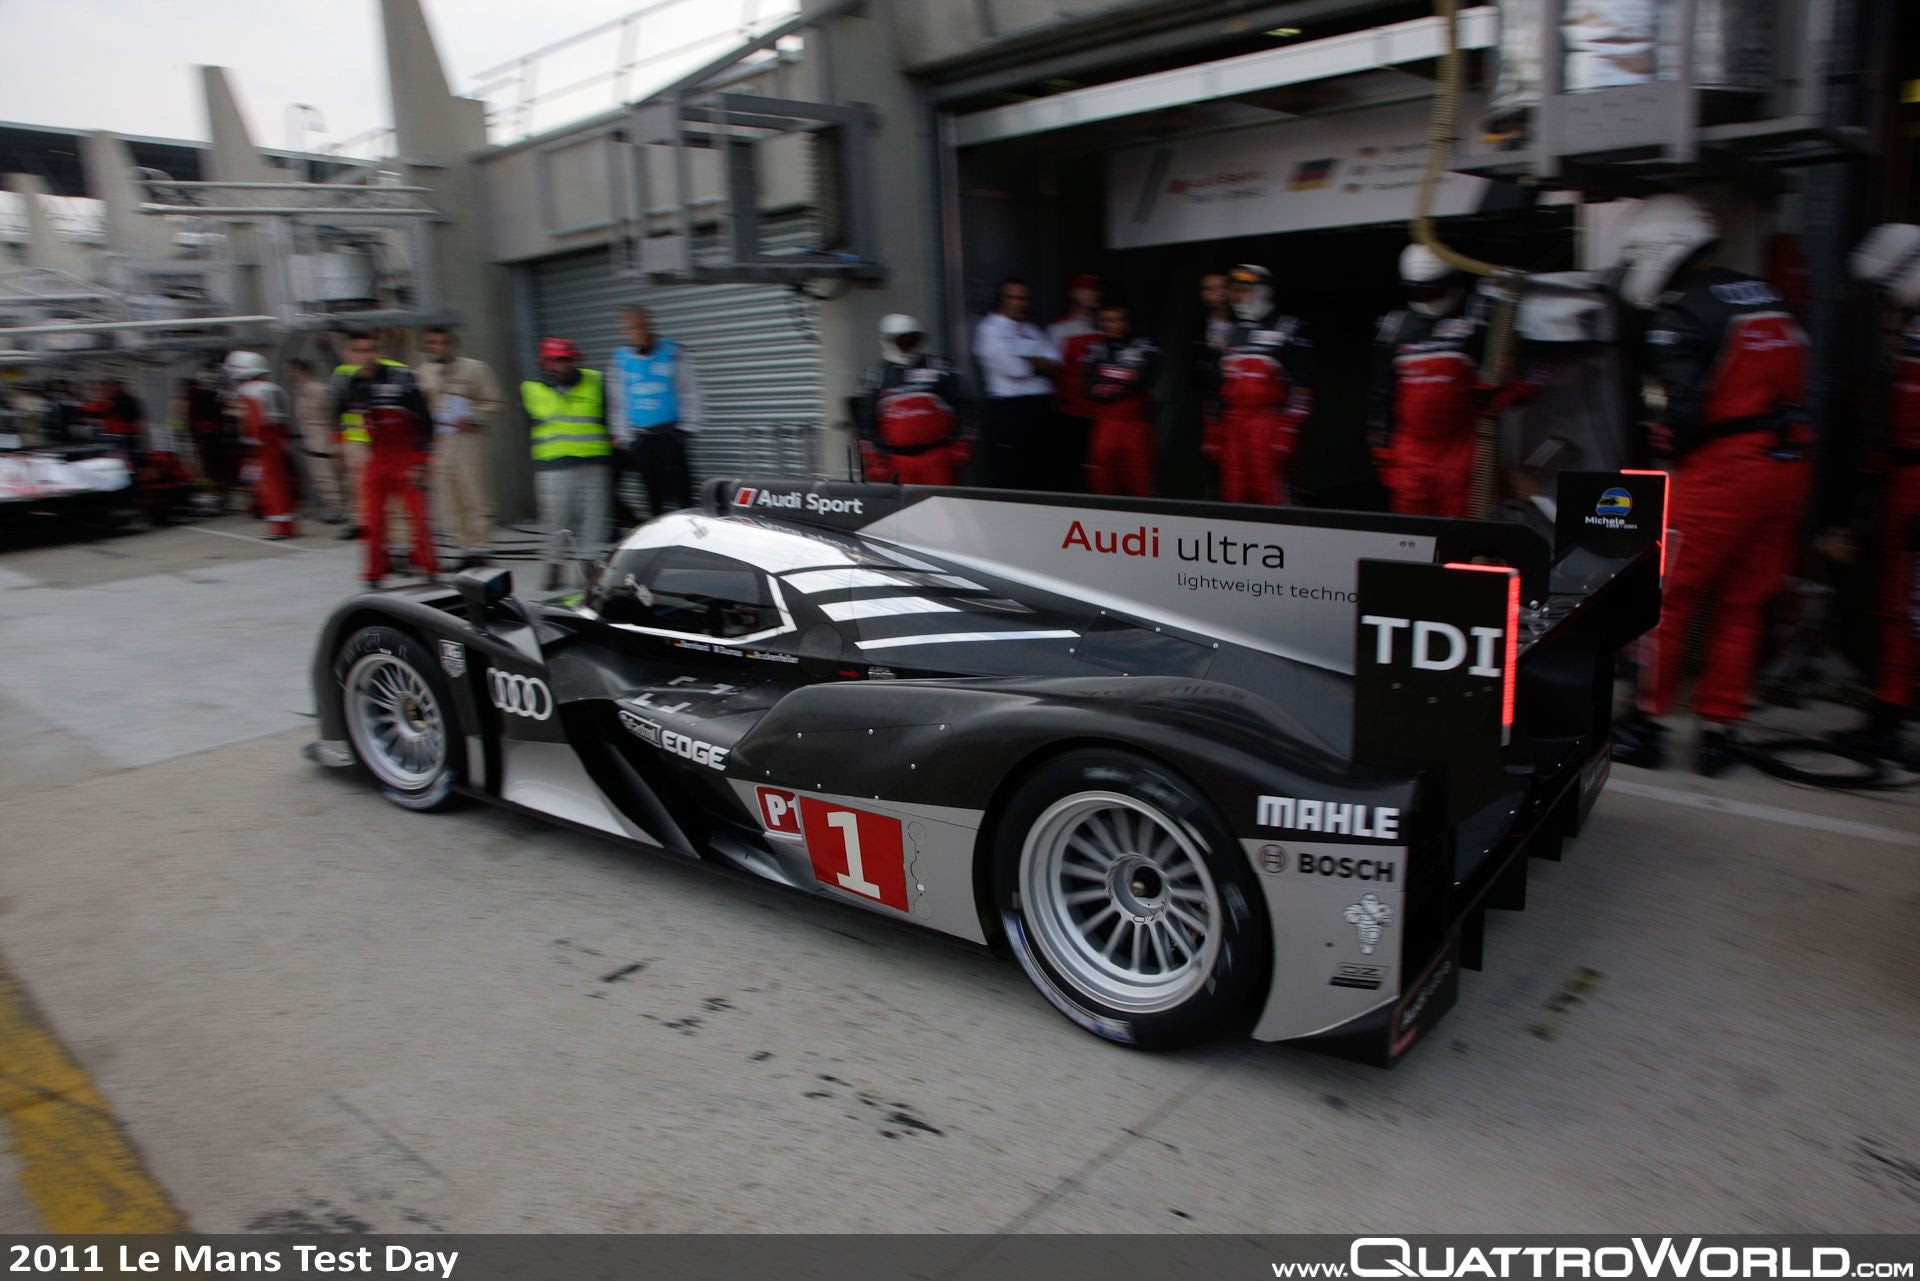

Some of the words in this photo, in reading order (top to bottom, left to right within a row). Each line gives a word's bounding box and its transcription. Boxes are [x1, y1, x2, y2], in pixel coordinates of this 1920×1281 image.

[757, 489, 802, 509] Audi
[806, 493, 863, 515] Sport
[1062, 520, 1159, 558] Audi
[1177, 531, 1285, 570] ultra
[1177, 573, 1283, 598] lightweight
[1361, 615, 1503, 678] TDI
[661, 729, 730, 771] EDGE
[1256, 795, 1400, 839] MAHLE
[827, 811, 881, 900] 1
[1299, 852, 1395, 883] BOSCH
